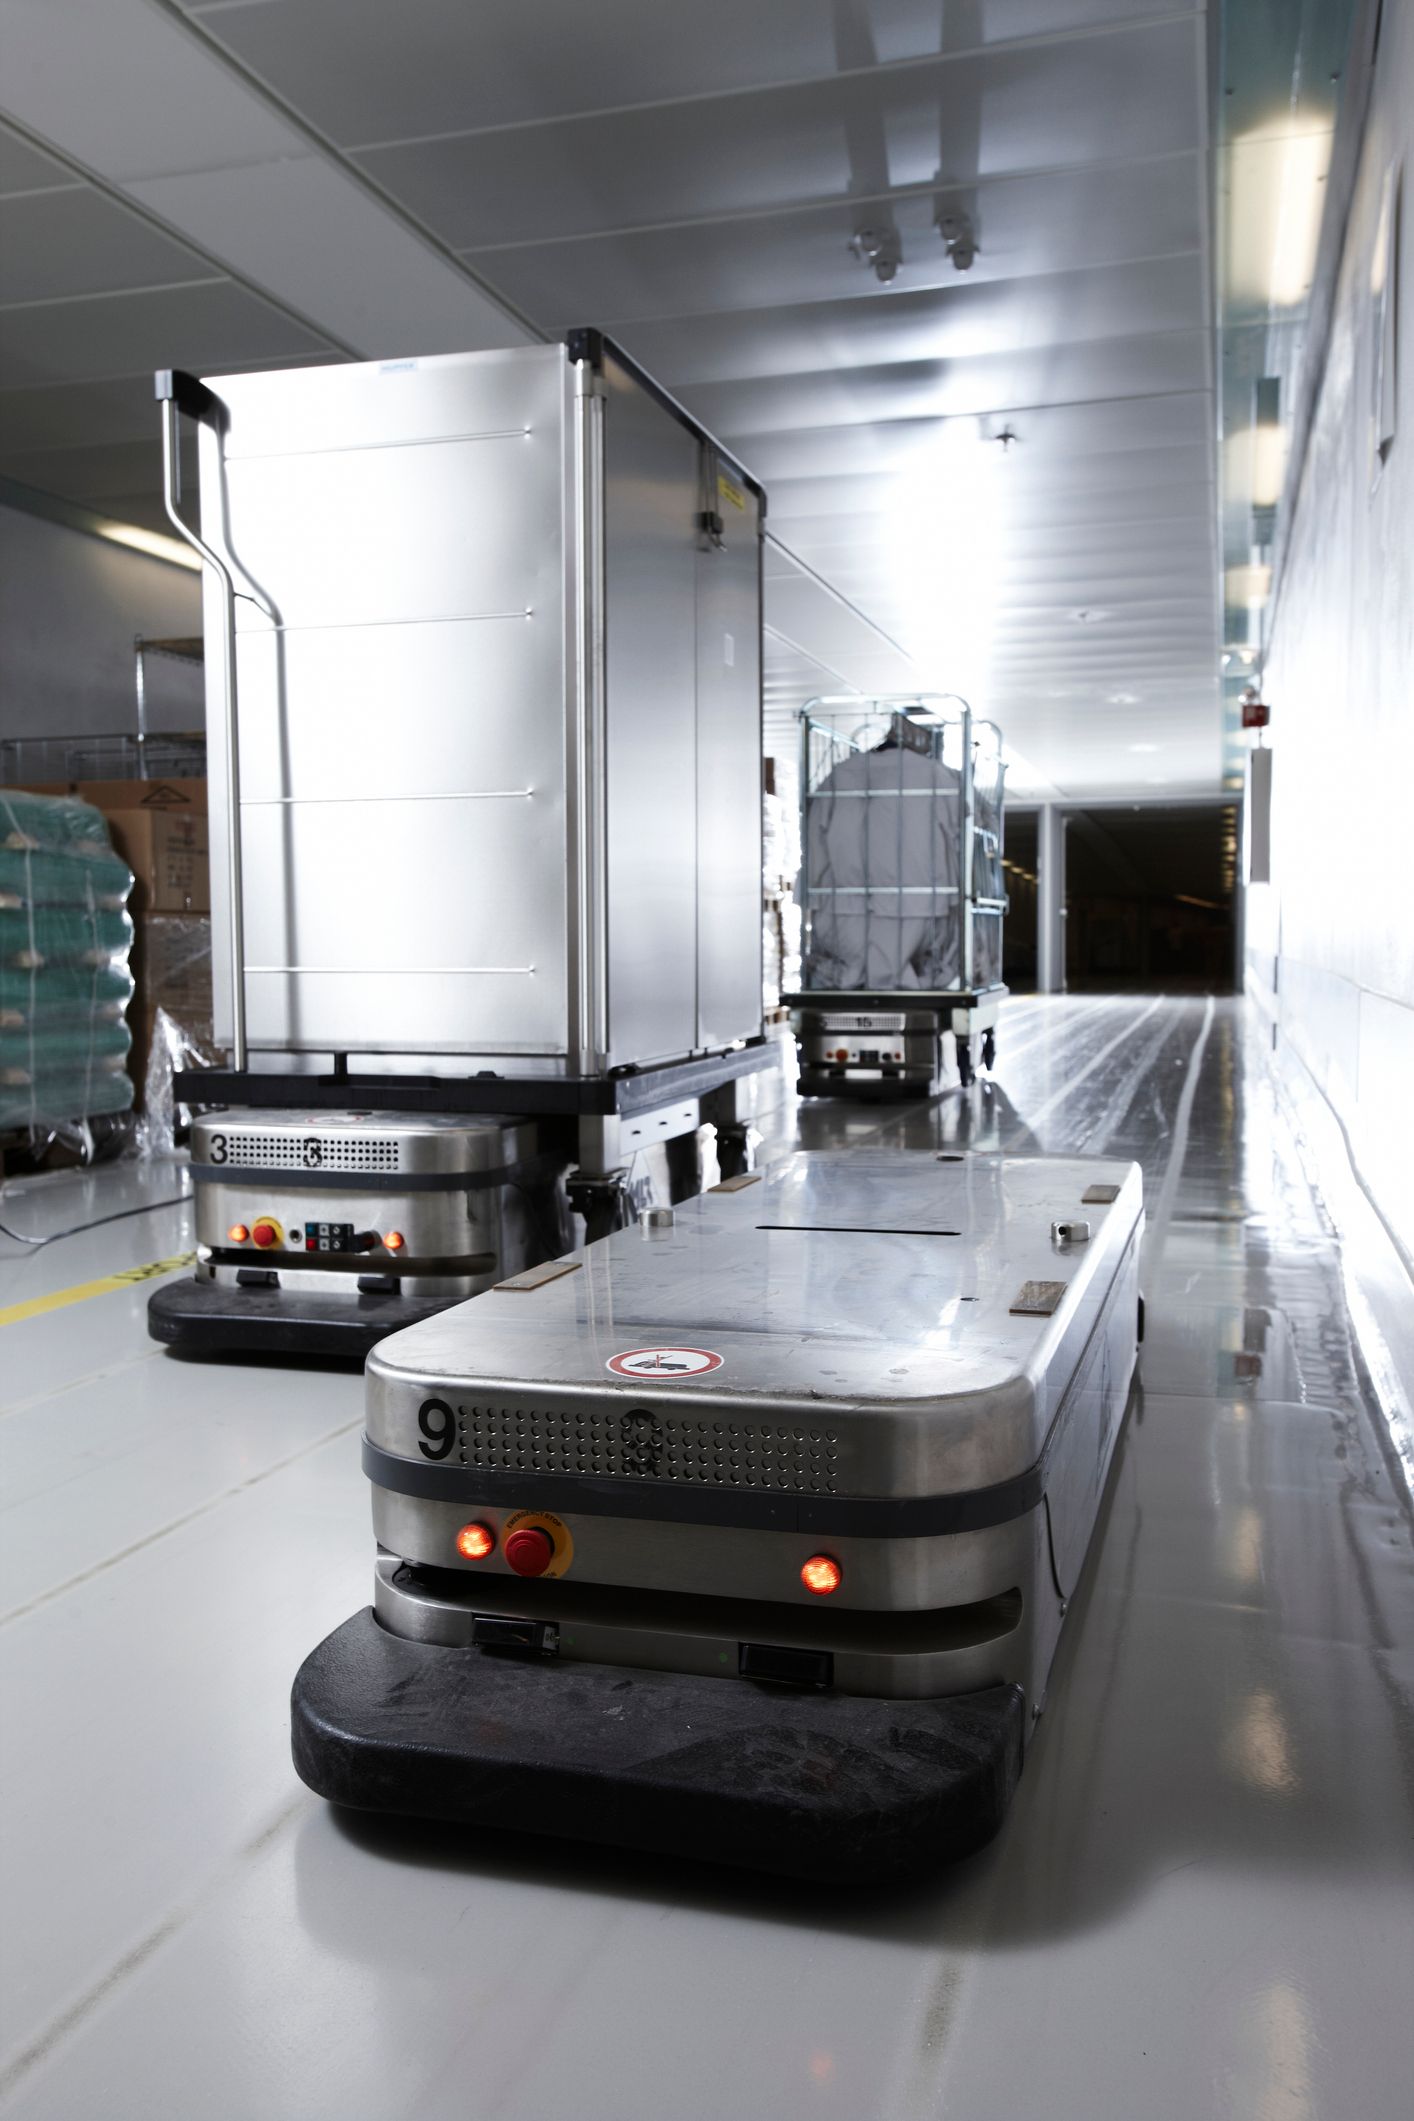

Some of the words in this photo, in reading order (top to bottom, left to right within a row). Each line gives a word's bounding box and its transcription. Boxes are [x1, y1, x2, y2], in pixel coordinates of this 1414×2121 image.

[210, 1134, 228, 1164] 3
[418, 1398, 456, 1461] 9
[543, 1512, 562, 1528] STOP
